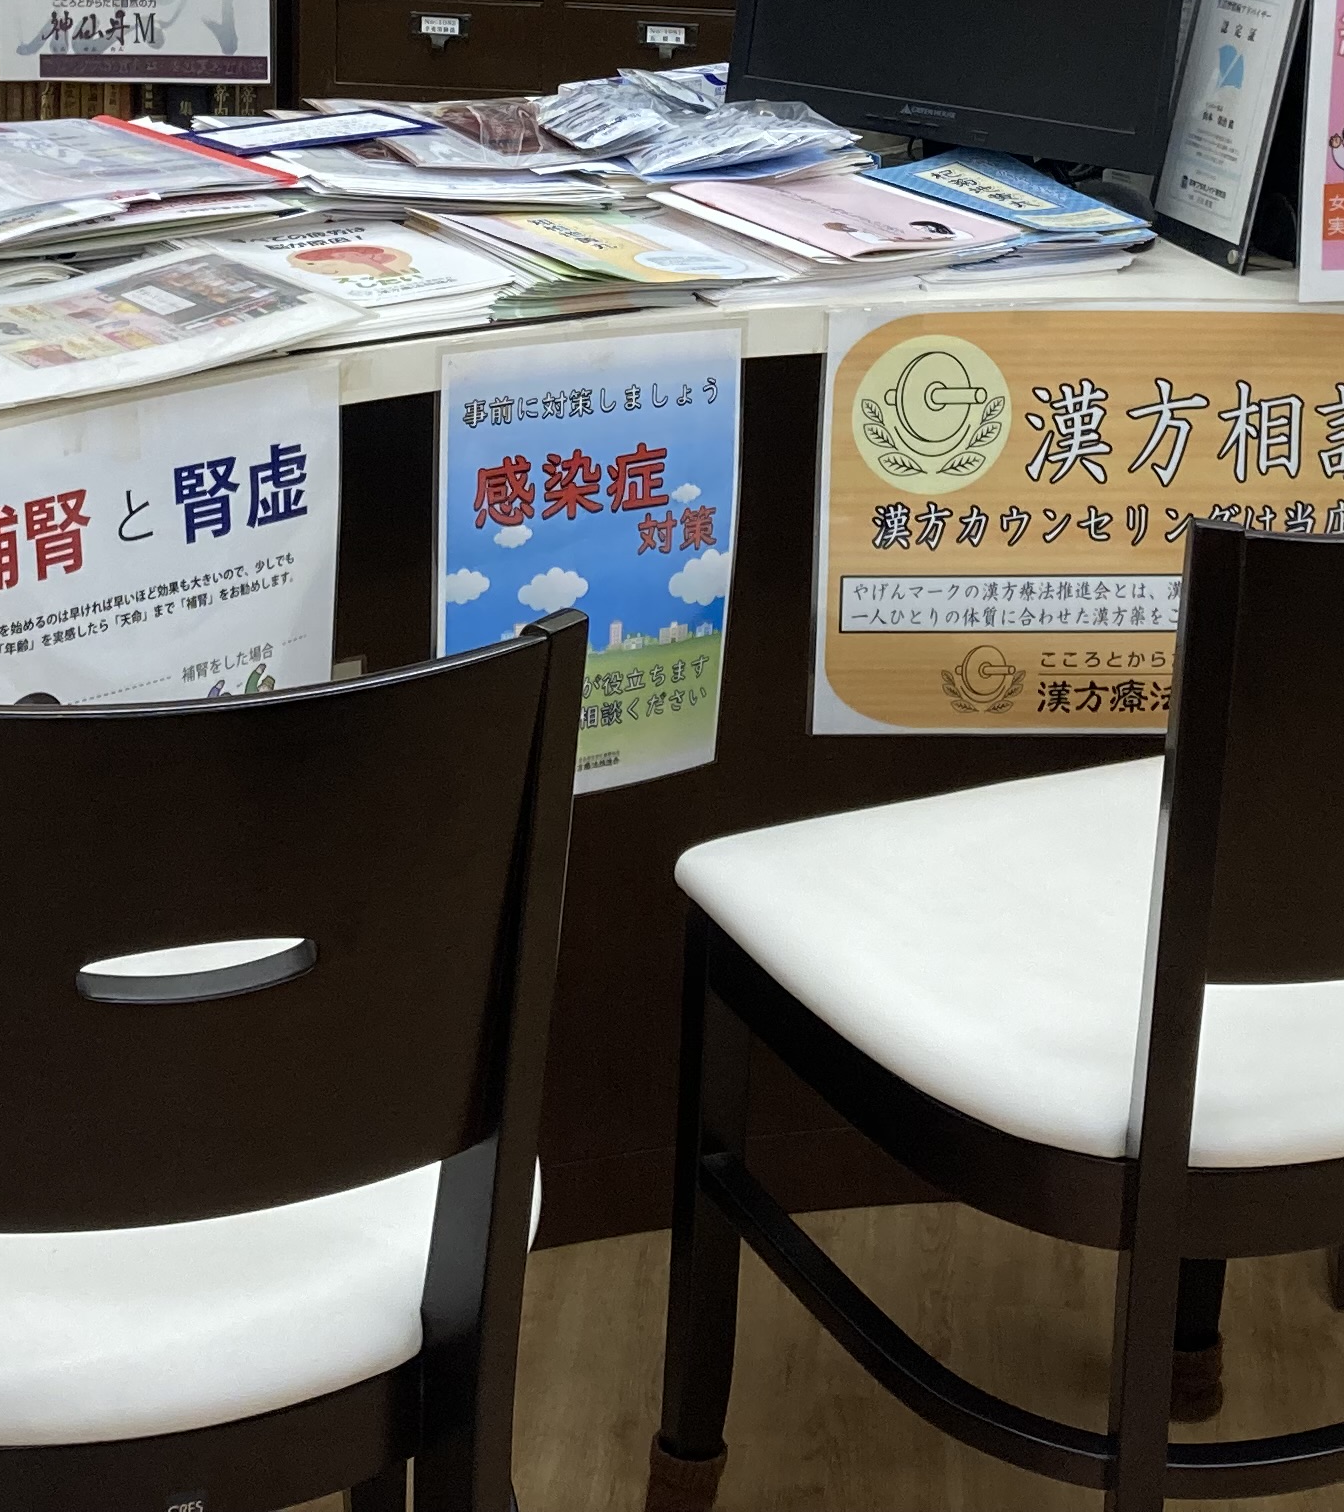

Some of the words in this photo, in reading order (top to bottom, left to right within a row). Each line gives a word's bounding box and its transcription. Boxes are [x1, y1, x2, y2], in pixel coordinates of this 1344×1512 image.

[462, 377, 720, 428] 事前に対策しましょう
[118, 490, 154, 542] と
[173, 444, 309, 544] 腎虚
[473, 441, 670, 530] 感染症
[637, 504, 718, 556] 対策
[181, 642, 274, 684] 補腎をした場合
